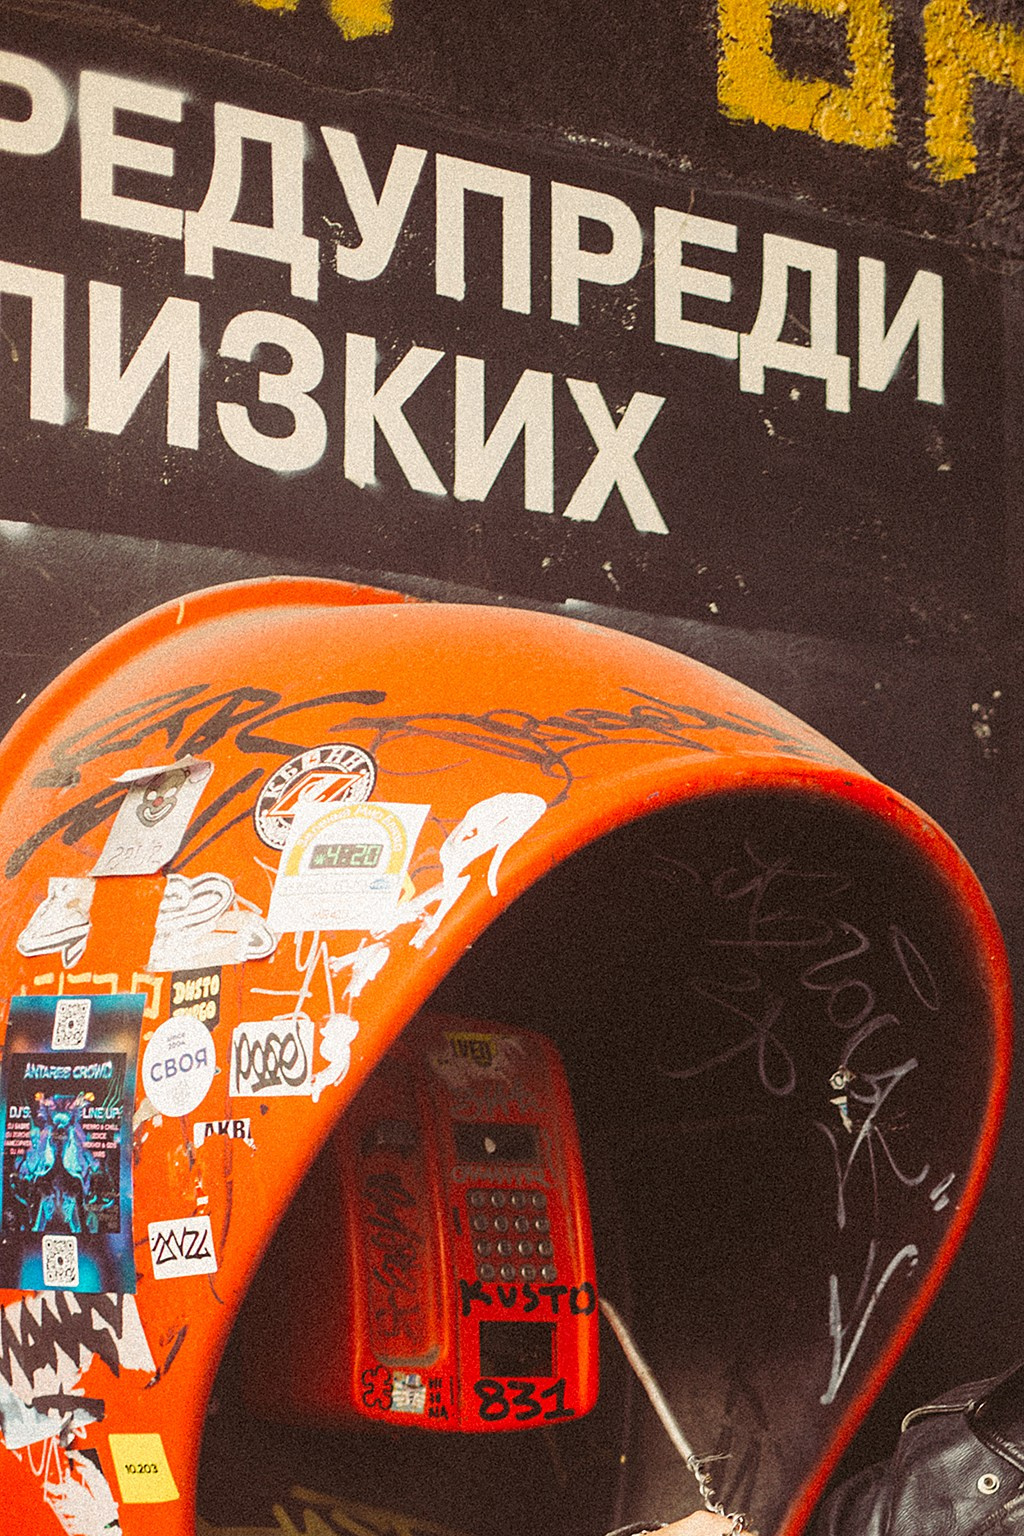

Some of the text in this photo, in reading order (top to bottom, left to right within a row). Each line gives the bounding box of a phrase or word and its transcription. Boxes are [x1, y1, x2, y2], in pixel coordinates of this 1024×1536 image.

[150, 1047, 208, 1082] СВОЯ
[459, 1279, 598, 1317] KUSTO
[473, 1378, 575, 1421] 831
[124, 1464, 159, 1475] 10.203
